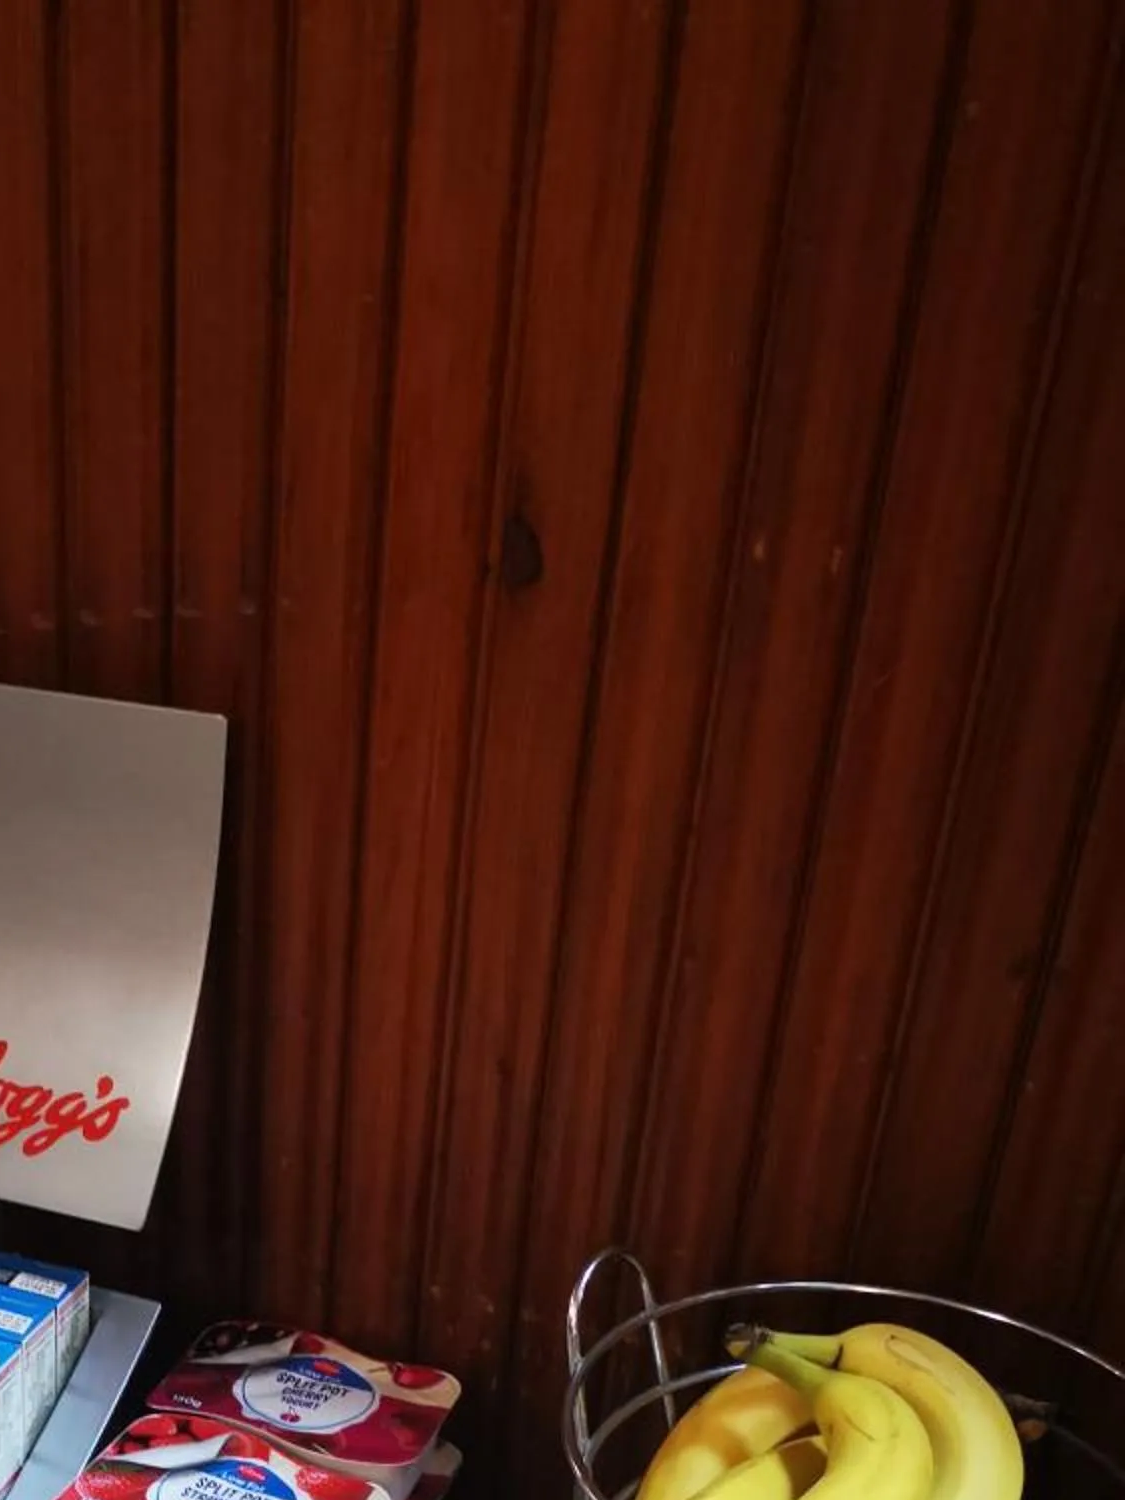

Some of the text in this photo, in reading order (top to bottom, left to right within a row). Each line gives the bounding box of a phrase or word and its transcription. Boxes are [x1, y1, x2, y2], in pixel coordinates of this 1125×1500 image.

[276, 1371, 350, 1399] SPLIT POT
[195, 1477, 237, 1499] SPLIT
